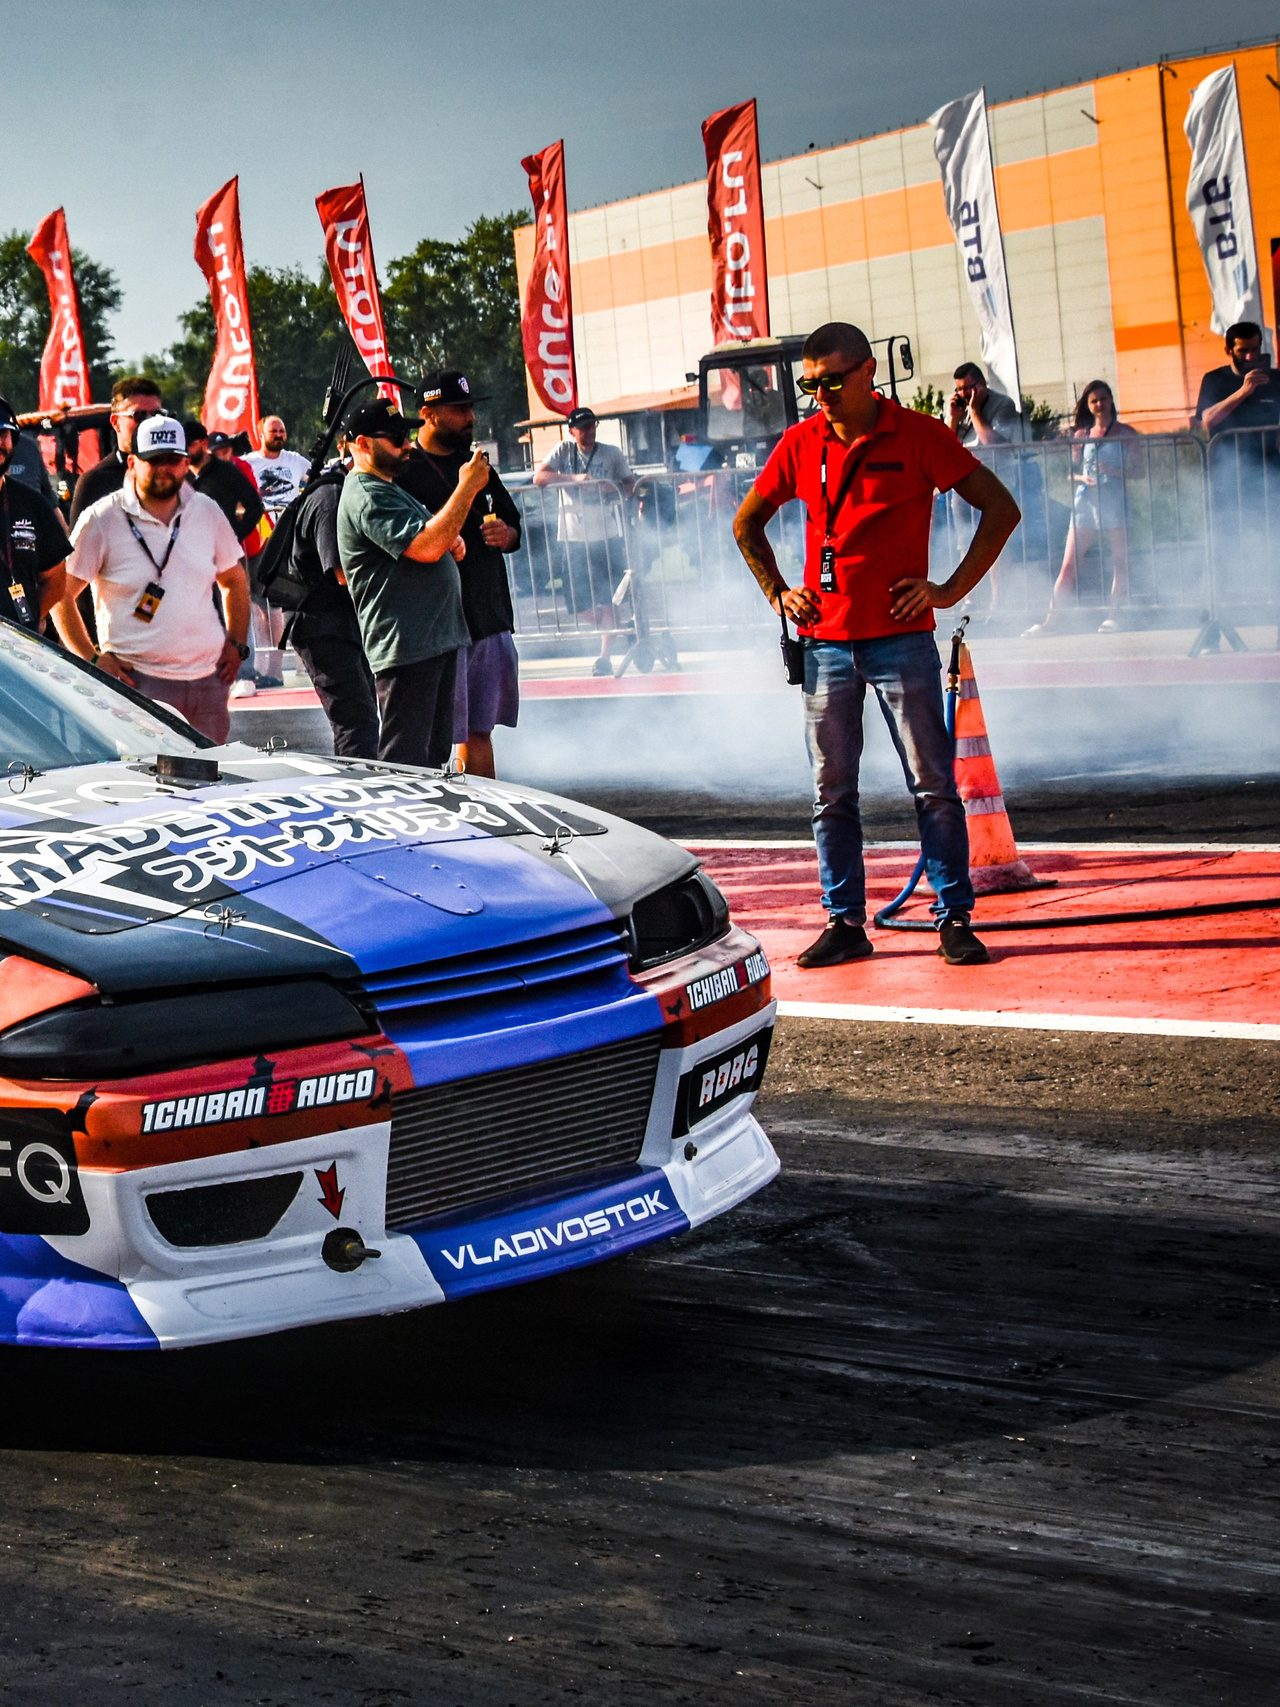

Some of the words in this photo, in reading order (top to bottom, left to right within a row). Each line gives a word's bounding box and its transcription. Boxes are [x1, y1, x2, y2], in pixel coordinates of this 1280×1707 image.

[150, 429, 177, 441] TOYS
[699, 1043, 760, 1108] RDRC
[440, 1189, 670, 1271] VLADIVOSTOK
